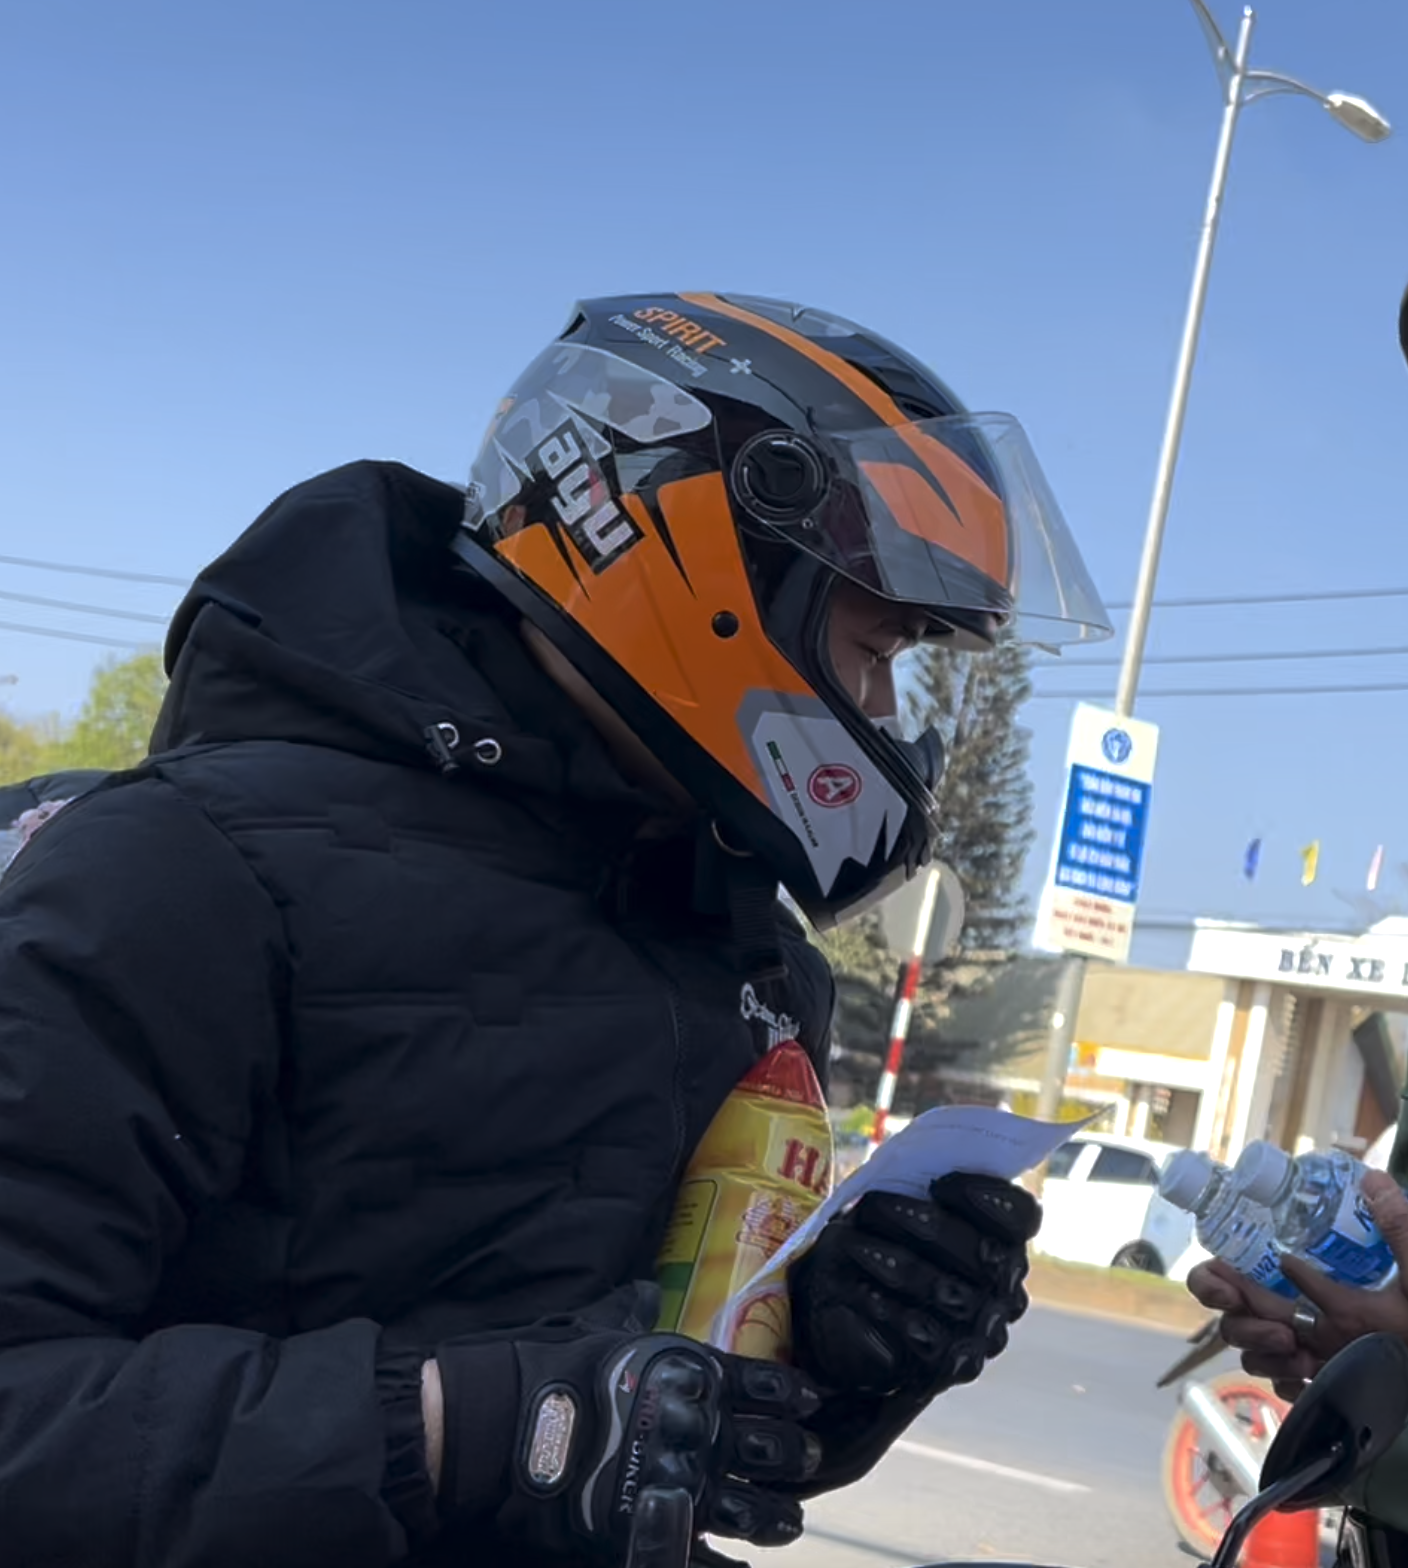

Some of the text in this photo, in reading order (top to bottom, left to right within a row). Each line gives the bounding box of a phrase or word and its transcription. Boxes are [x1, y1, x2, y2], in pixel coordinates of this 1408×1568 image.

[633, 306, 727, 354] SPIRIT
[636, 327, 670, 350] Sport
[666, 345, 708, 378] Racing
[1278, 937, 1334, 976] BẾN
[1345, 956, 1386, 983] XE
